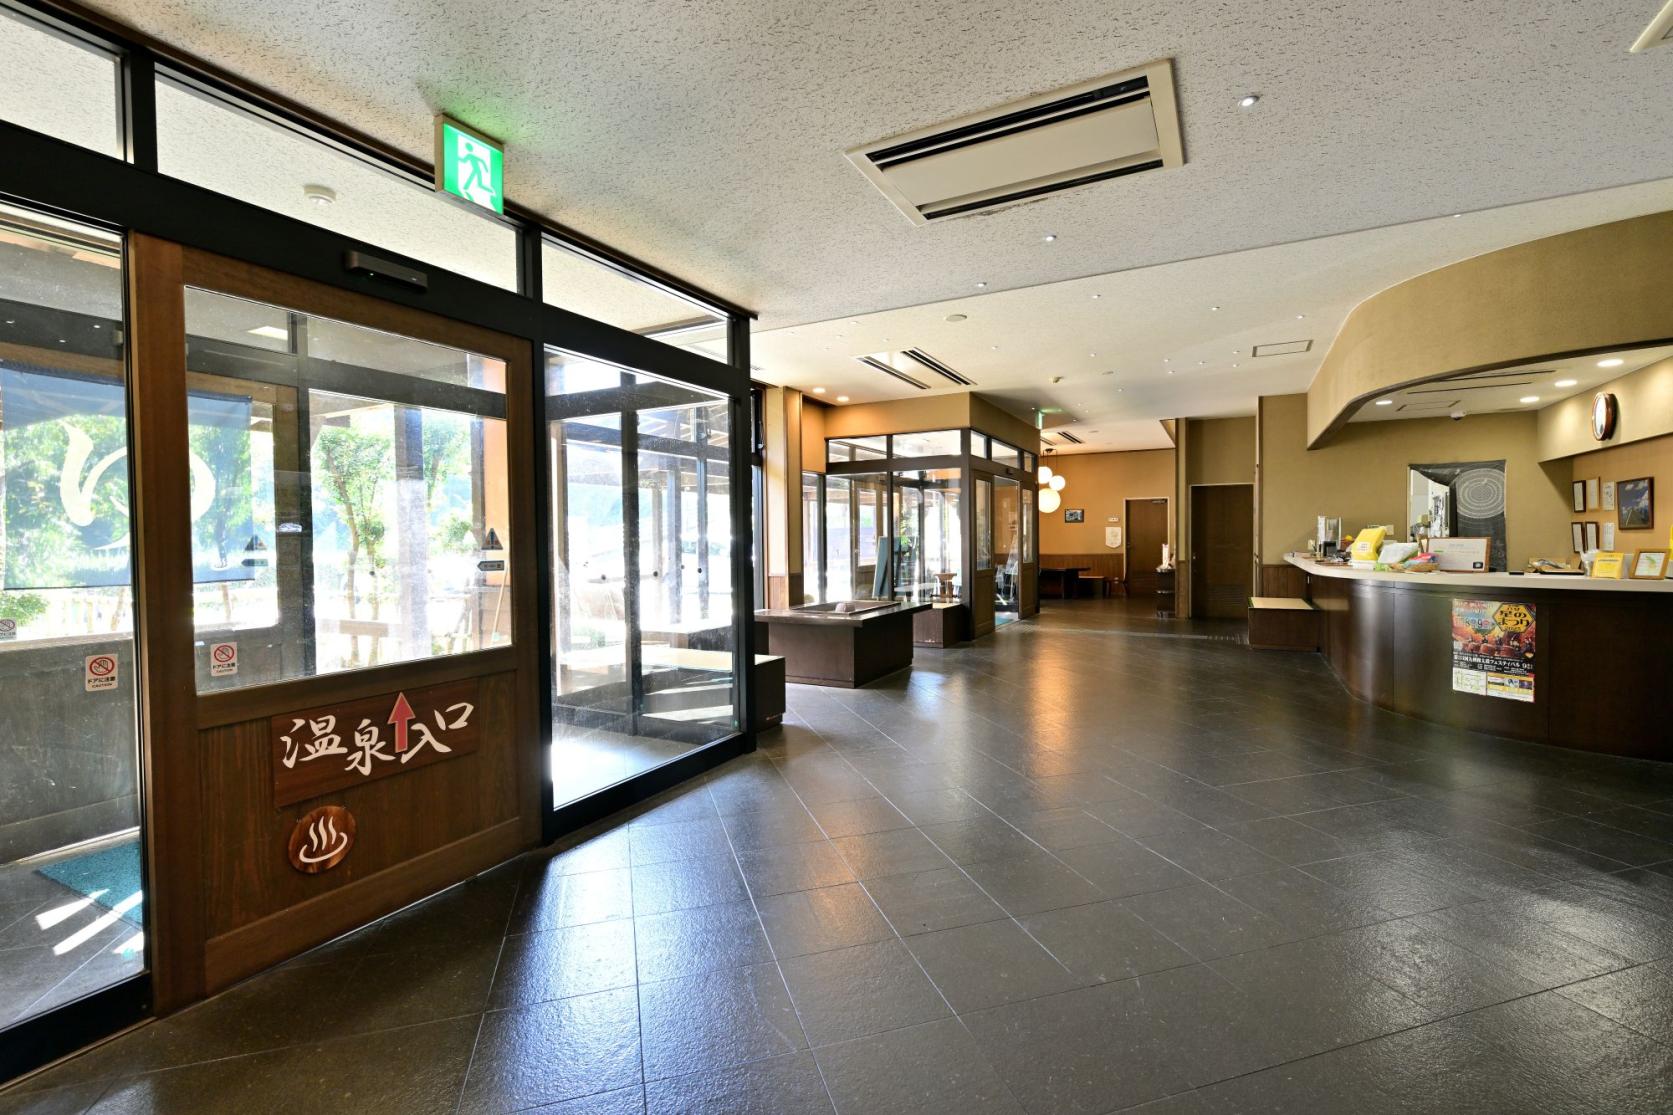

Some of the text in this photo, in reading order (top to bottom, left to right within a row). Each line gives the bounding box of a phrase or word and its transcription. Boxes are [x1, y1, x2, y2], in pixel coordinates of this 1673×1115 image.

[87, 676, 116, 684] ドアに注意
[279, 702, 475, 776] 温泉入口
